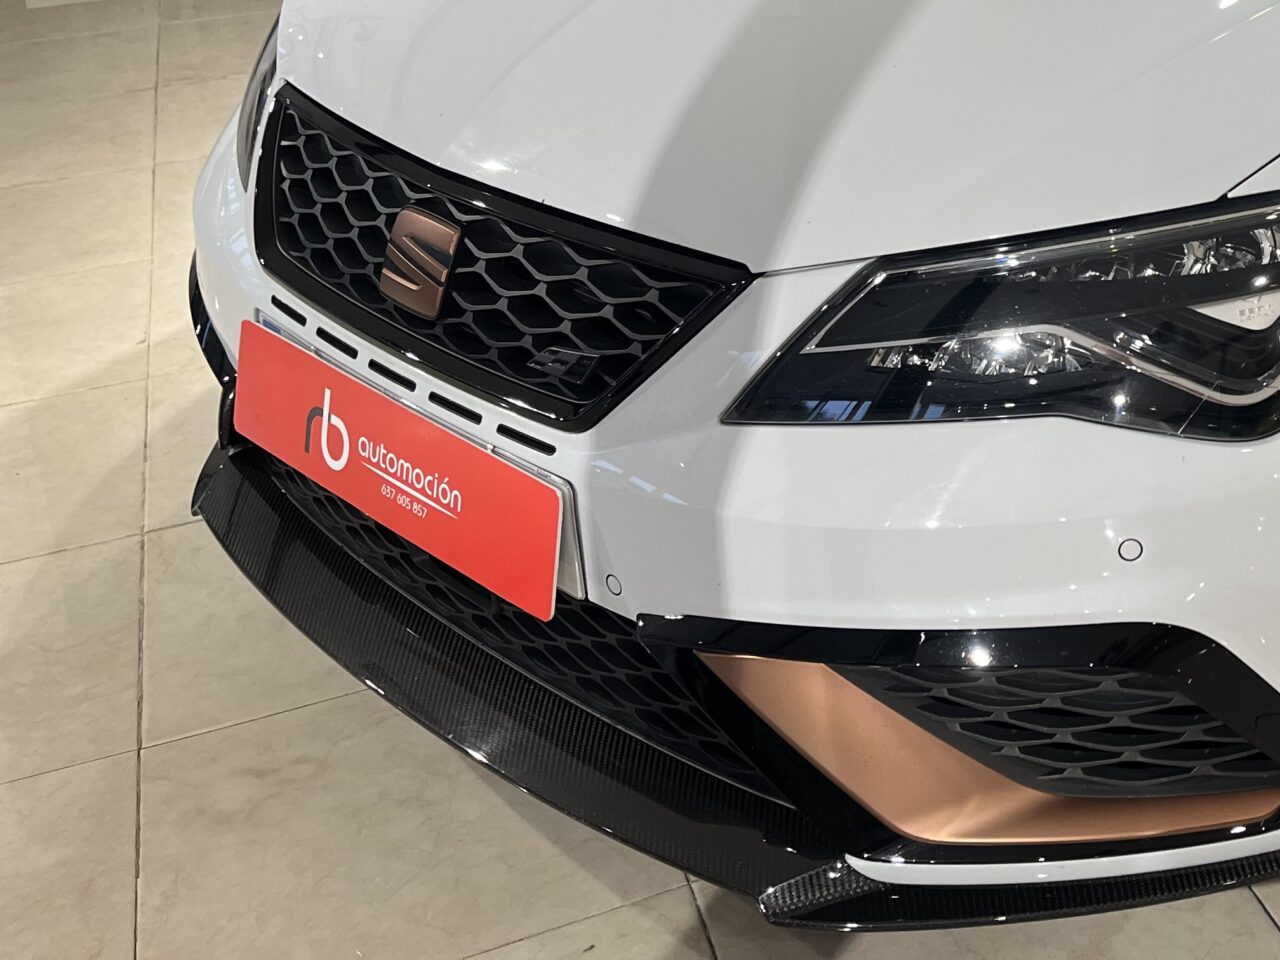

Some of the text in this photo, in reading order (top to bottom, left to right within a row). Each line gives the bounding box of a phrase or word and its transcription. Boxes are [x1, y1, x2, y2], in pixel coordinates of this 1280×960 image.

[304, 387, 462, 512] rb automoción
[381, 484, 427, 518] 637 605 857
